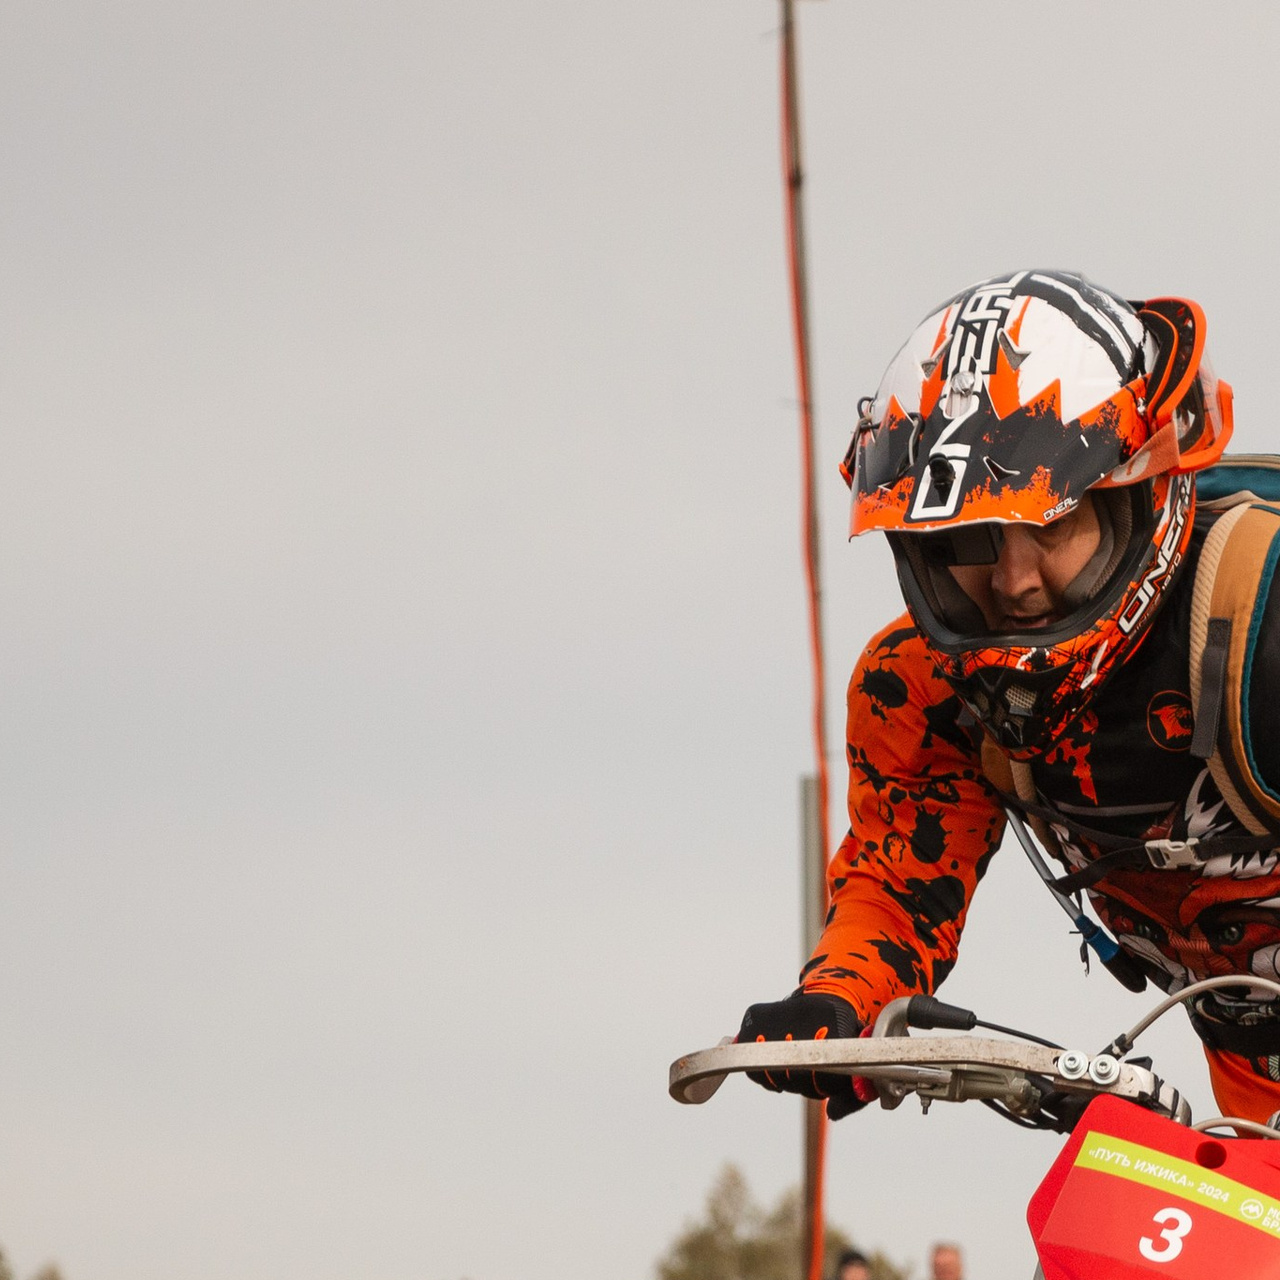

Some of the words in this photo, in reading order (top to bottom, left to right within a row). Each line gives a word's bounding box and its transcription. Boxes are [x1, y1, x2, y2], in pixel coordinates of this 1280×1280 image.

[1088, 1146, 1132, 1168] «ПУТЬ
[1133, 1157, 1194, 1188] ИЖИКА»
[1196, 1181, 1230, 1203] 2024
[1138, 1207, 1193, 1263] 3
